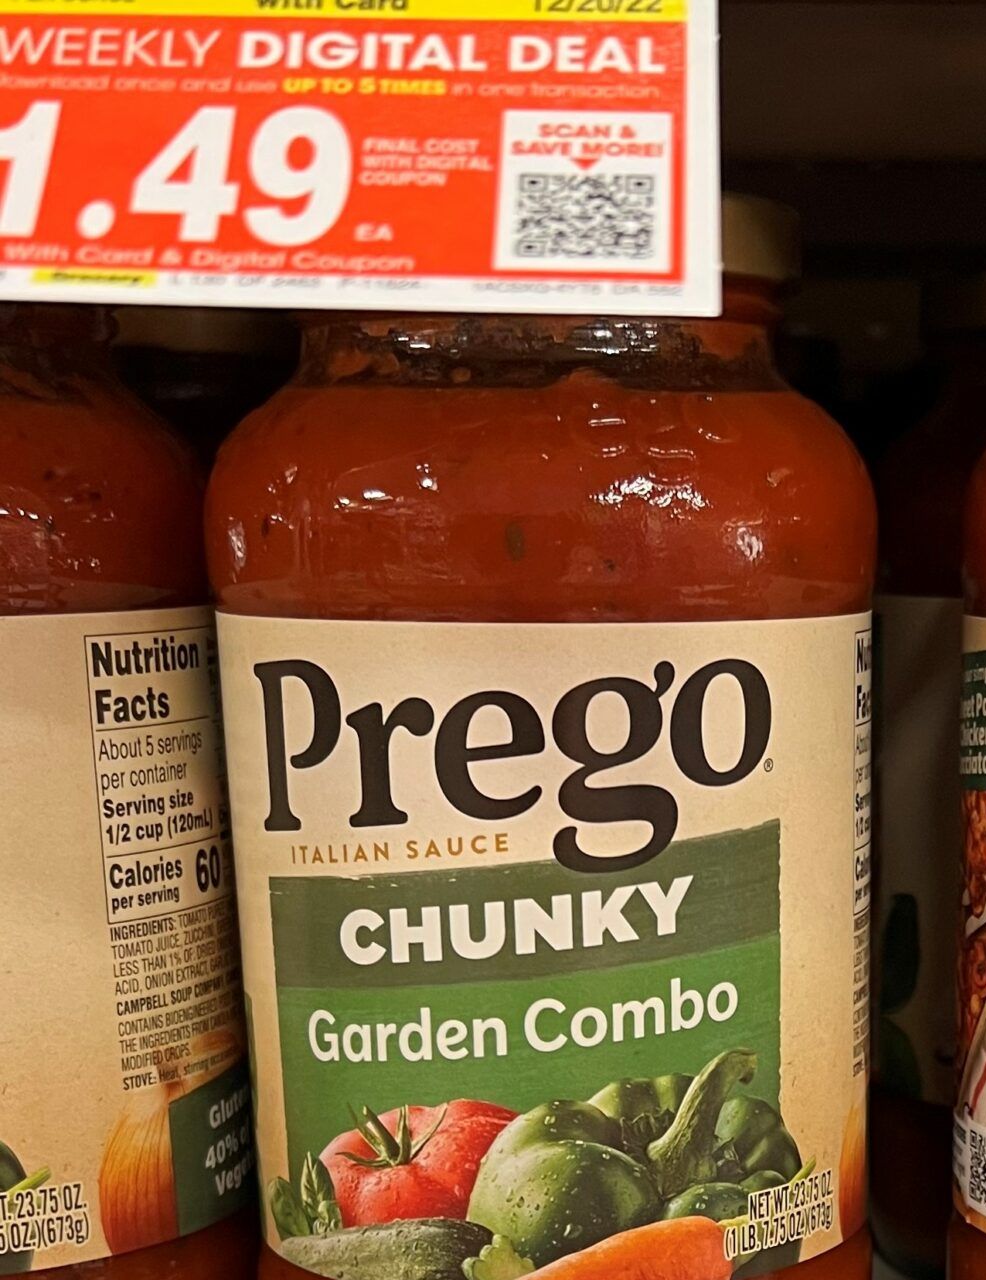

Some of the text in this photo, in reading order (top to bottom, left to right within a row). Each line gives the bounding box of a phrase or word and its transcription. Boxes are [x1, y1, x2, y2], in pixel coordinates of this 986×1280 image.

[0, 26, 666, 73] WEEKLY DIGITAL DEAL
[362, 137, 480, 154] FINAL COST
[538, 123, 612, 139] SCAN
[511, 140, 665, 159] SAVE MORE!
[0, 100, 352, 247] 1.49
[358, 170, 448, 186] COUPON
[353, 222, 393, 242] EA
[2, 243, 415, 274] With Card Digital Coupon
[91, 636, 199, 678] Nutrition
[95, 687, 170, 724] Facts
[99, 730, 202, 761] About 5 servings
[101, 761, 187, 796] per container
[253, 658, 773, 874] Prego
[103, 788, 194, 819] Serving size
[106, 807, 213, 846] 1/2 cup (120mL)
[290, 832, 510, 866] ITALIAN SAUCE
[109, 845, 221, 893] Calories 60
[111, 884, 180, 914] per serving
[110, 917, 177, 942] INGREDIENTS:
[339, 874, 695, 967] CHUNKY
[111, 938, 153, 960] TOMATO
[113, 953, 182, 978] LESS THAN 1%
[145, 970, 174, 991] ONION
[117, 986, 193, 1016] CAMPBELL SOUP
[118, 1014, 164, 1037] CONTAINS
[307, 976, 740, 1063] Garden Combo
[119, 1024, 191, 1055] THE INGREDIENTS
[121, 1049, 163, 1072] MODIFIED
[123, 1071, 157, 1092] STOVE:
[205, 1132, 239, 1170] 40%
[17, 1184, 87, 1219] 23.75 OZ.
[749, 1191, 771, 1221] NET
[794, 1175, 820, 1208] 23.75
[762, 1215, 786, 1249] 7.75
